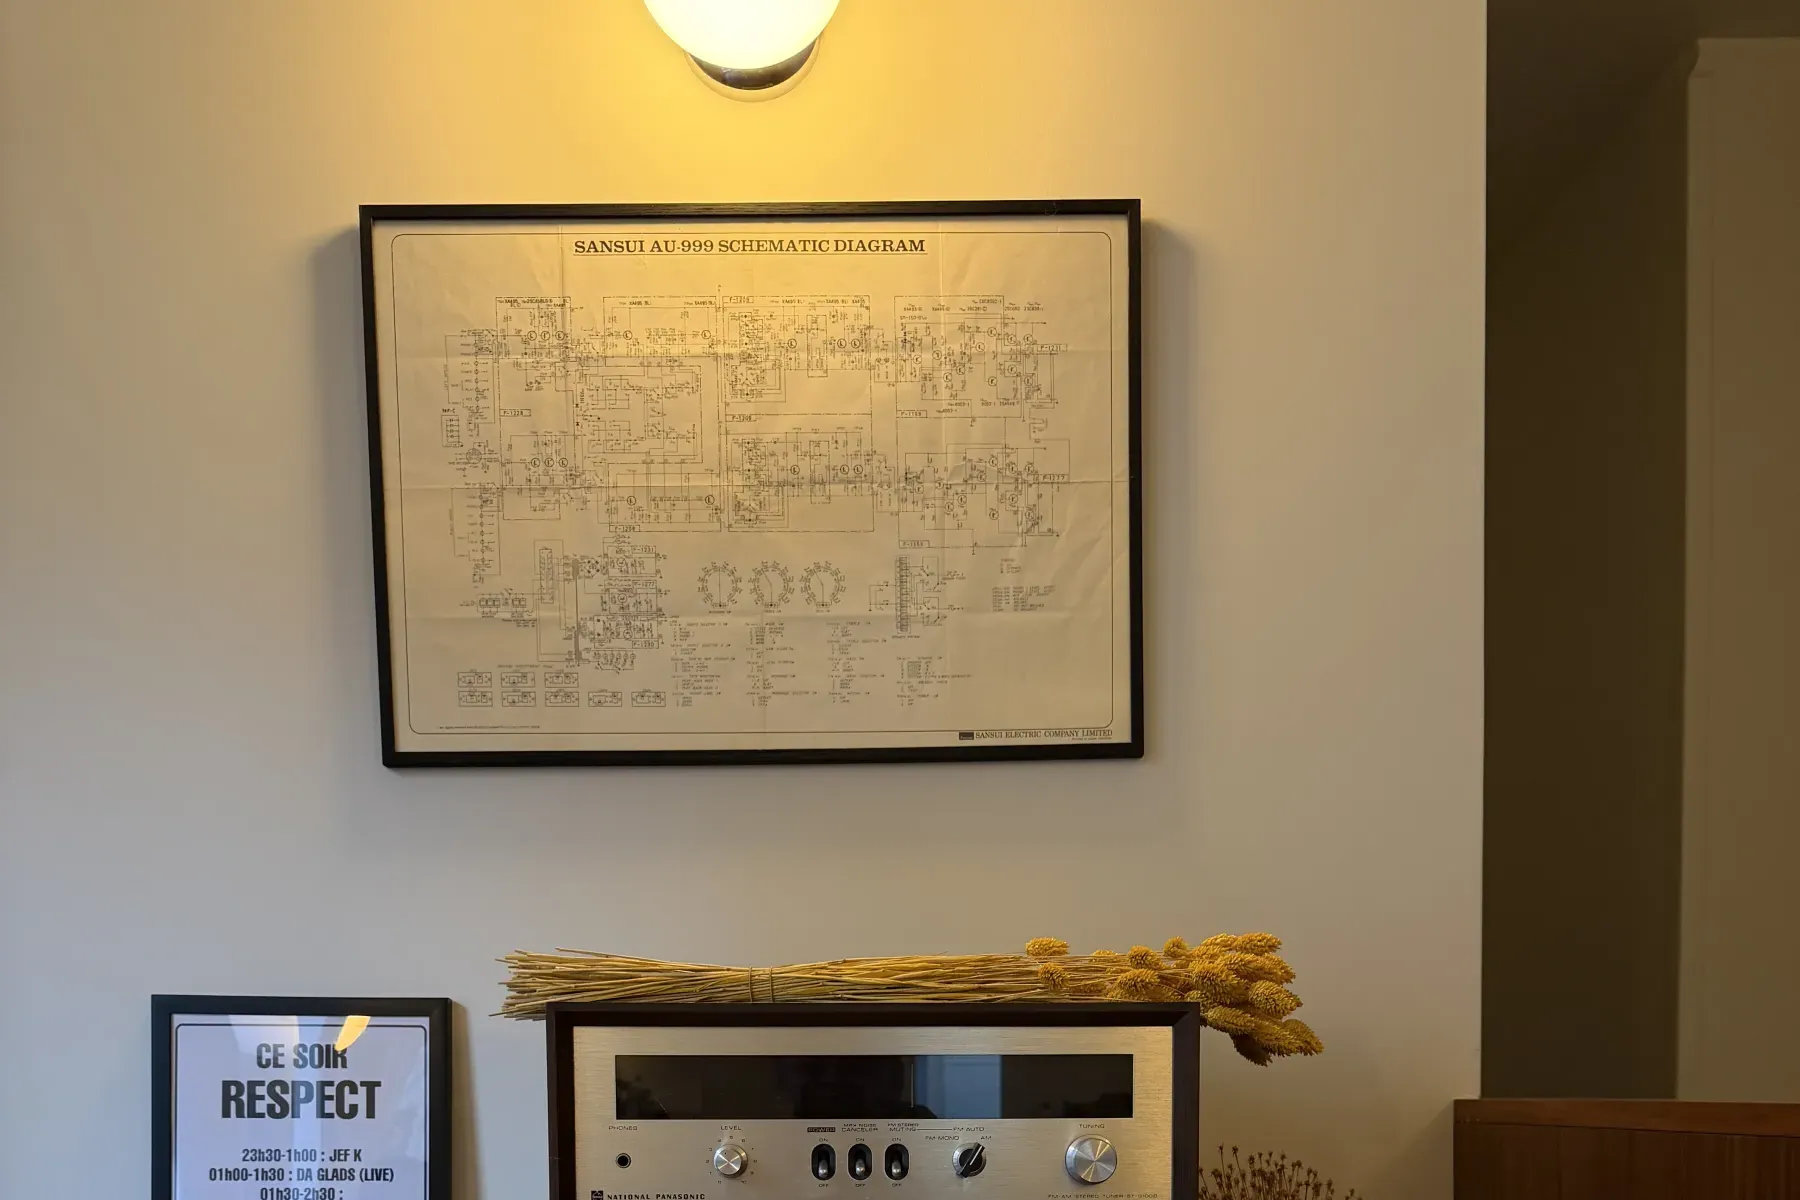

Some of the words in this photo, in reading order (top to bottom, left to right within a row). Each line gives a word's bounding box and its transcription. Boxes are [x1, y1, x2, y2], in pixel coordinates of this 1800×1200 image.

[574, 240, 646, 254] SANSUI
[650, 240, 714, 253] AU-999
[718, 239, 830, 253] SCHEMATIC
[833, 239, 925, 252] DIAGRAM
[1044, 730, 1079, 738] COMPANY
[1081, 729, 1113, 737] LIMITED
[256, 1043, 285, 1069] CE
[293, 1043, 348, 1069] SOIR
[221, 1079, 382, 1120] RESPECT
[242, 1148, 317, 1163] 23h30-1h00
[329, 1148, 350, 1163] JEF
[354, 1148, 363, 1163] K
[209, 1167, 284, 1182] 01h00-1h30
[297, 1167, 312, 1182] DA
[317, 1167, 355, 1182] GLADS
[359, 1167, 394, 1183] (LIVE)
[260, 1187, 335, 1200] 01h30-2h30
